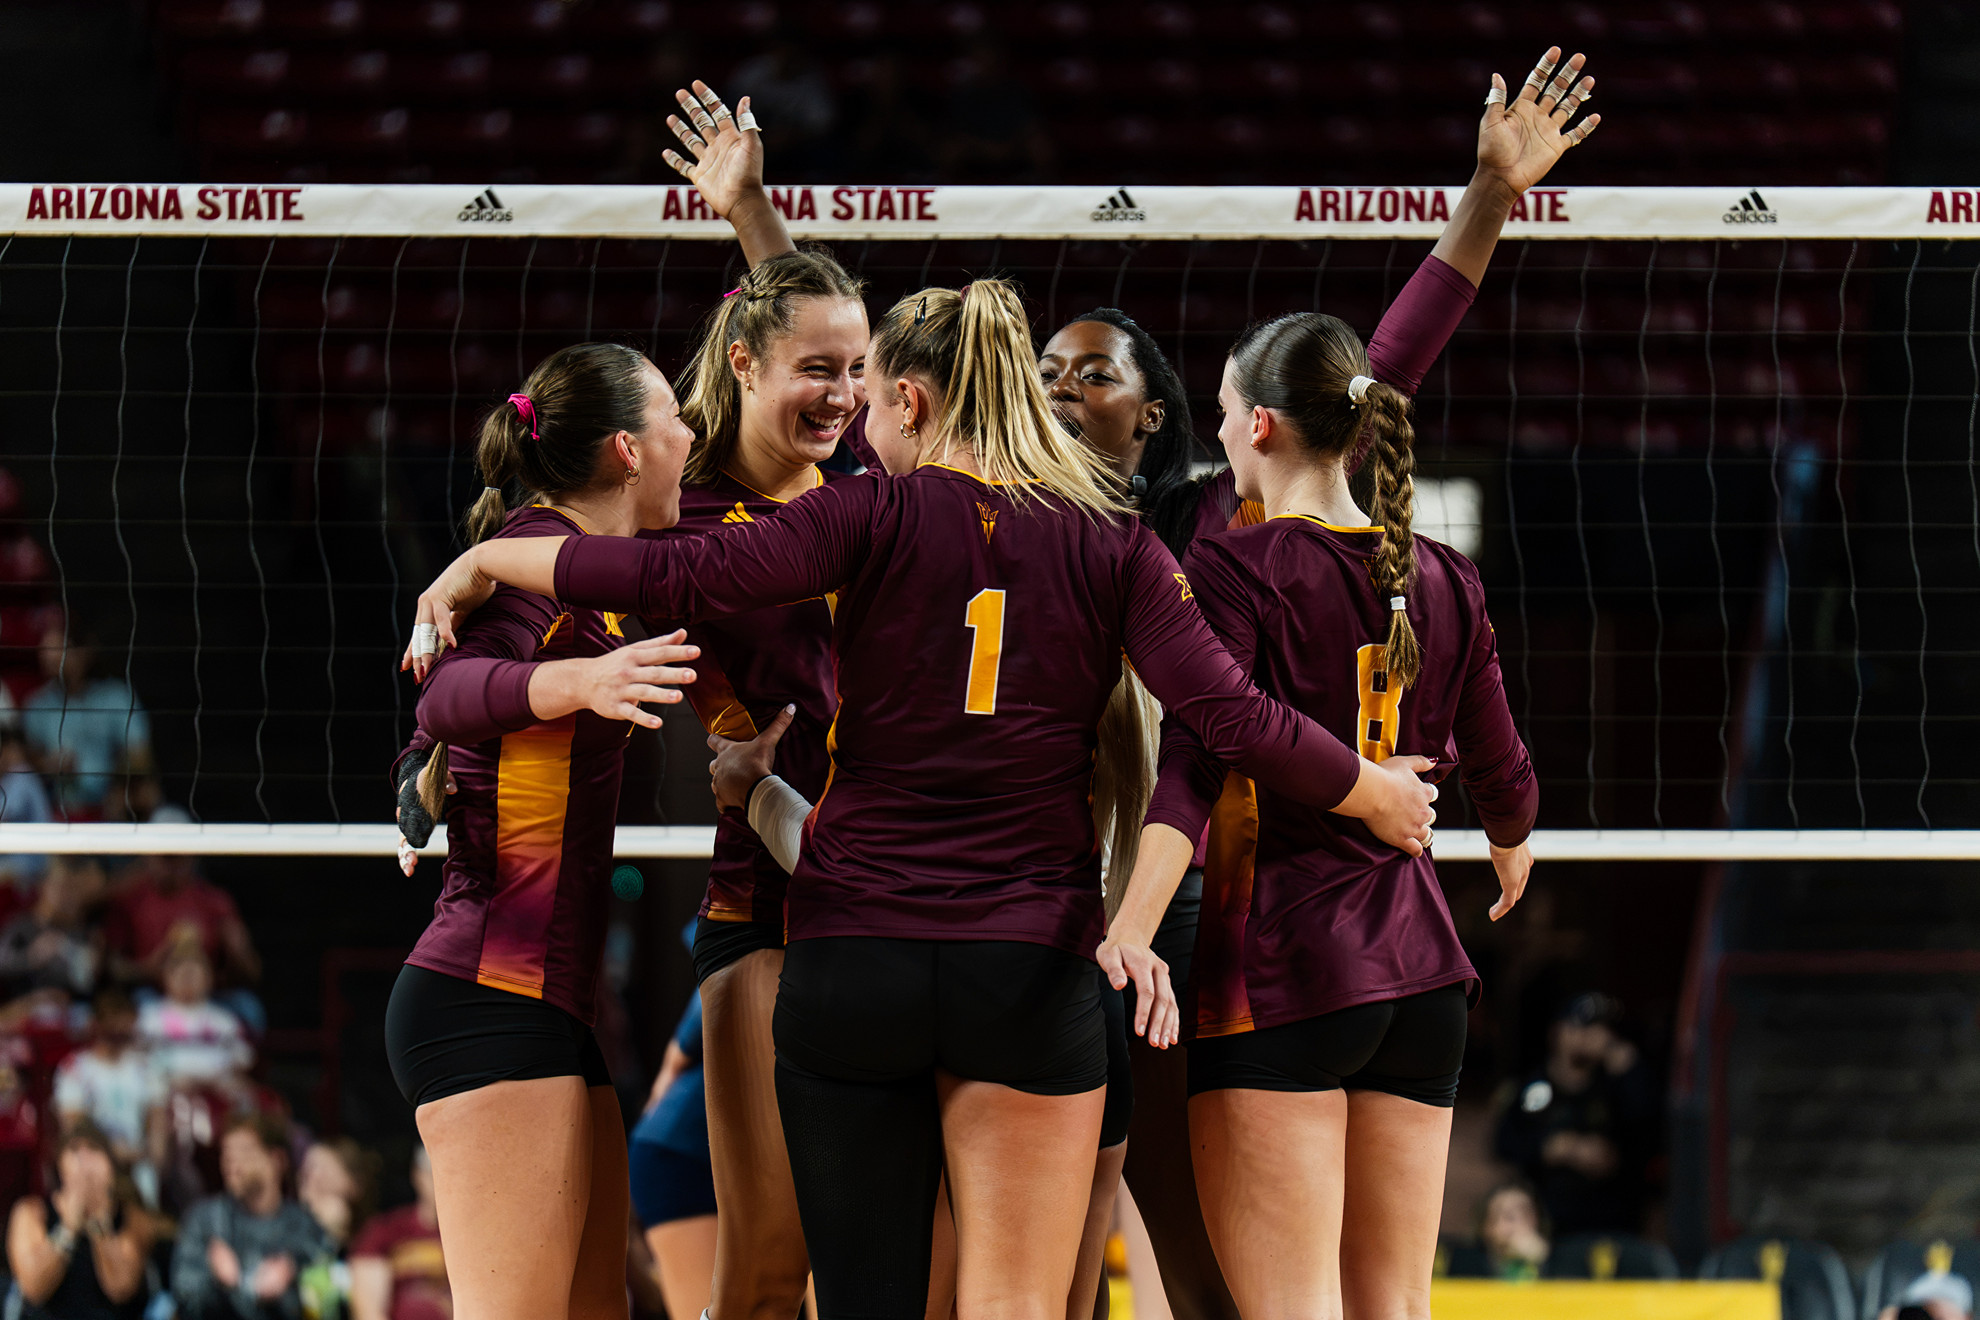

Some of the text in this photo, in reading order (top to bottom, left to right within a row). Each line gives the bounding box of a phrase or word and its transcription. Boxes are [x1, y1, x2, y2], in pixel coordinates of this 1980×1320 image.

[27, 187, 303, 220] ARIZONA STATE
[457, 207, 513, 222] adidas
[662, 187, 937, 221] ARNA STATE
[1091, 207, 1145, 222] adidas
[1295, 188, 1569, 222] ARIZONA ATE
[1722, 210, 1777, 224] adidas
[964, 588, 1006, 715] 1
[1357, 643, 1404, 764] 8
